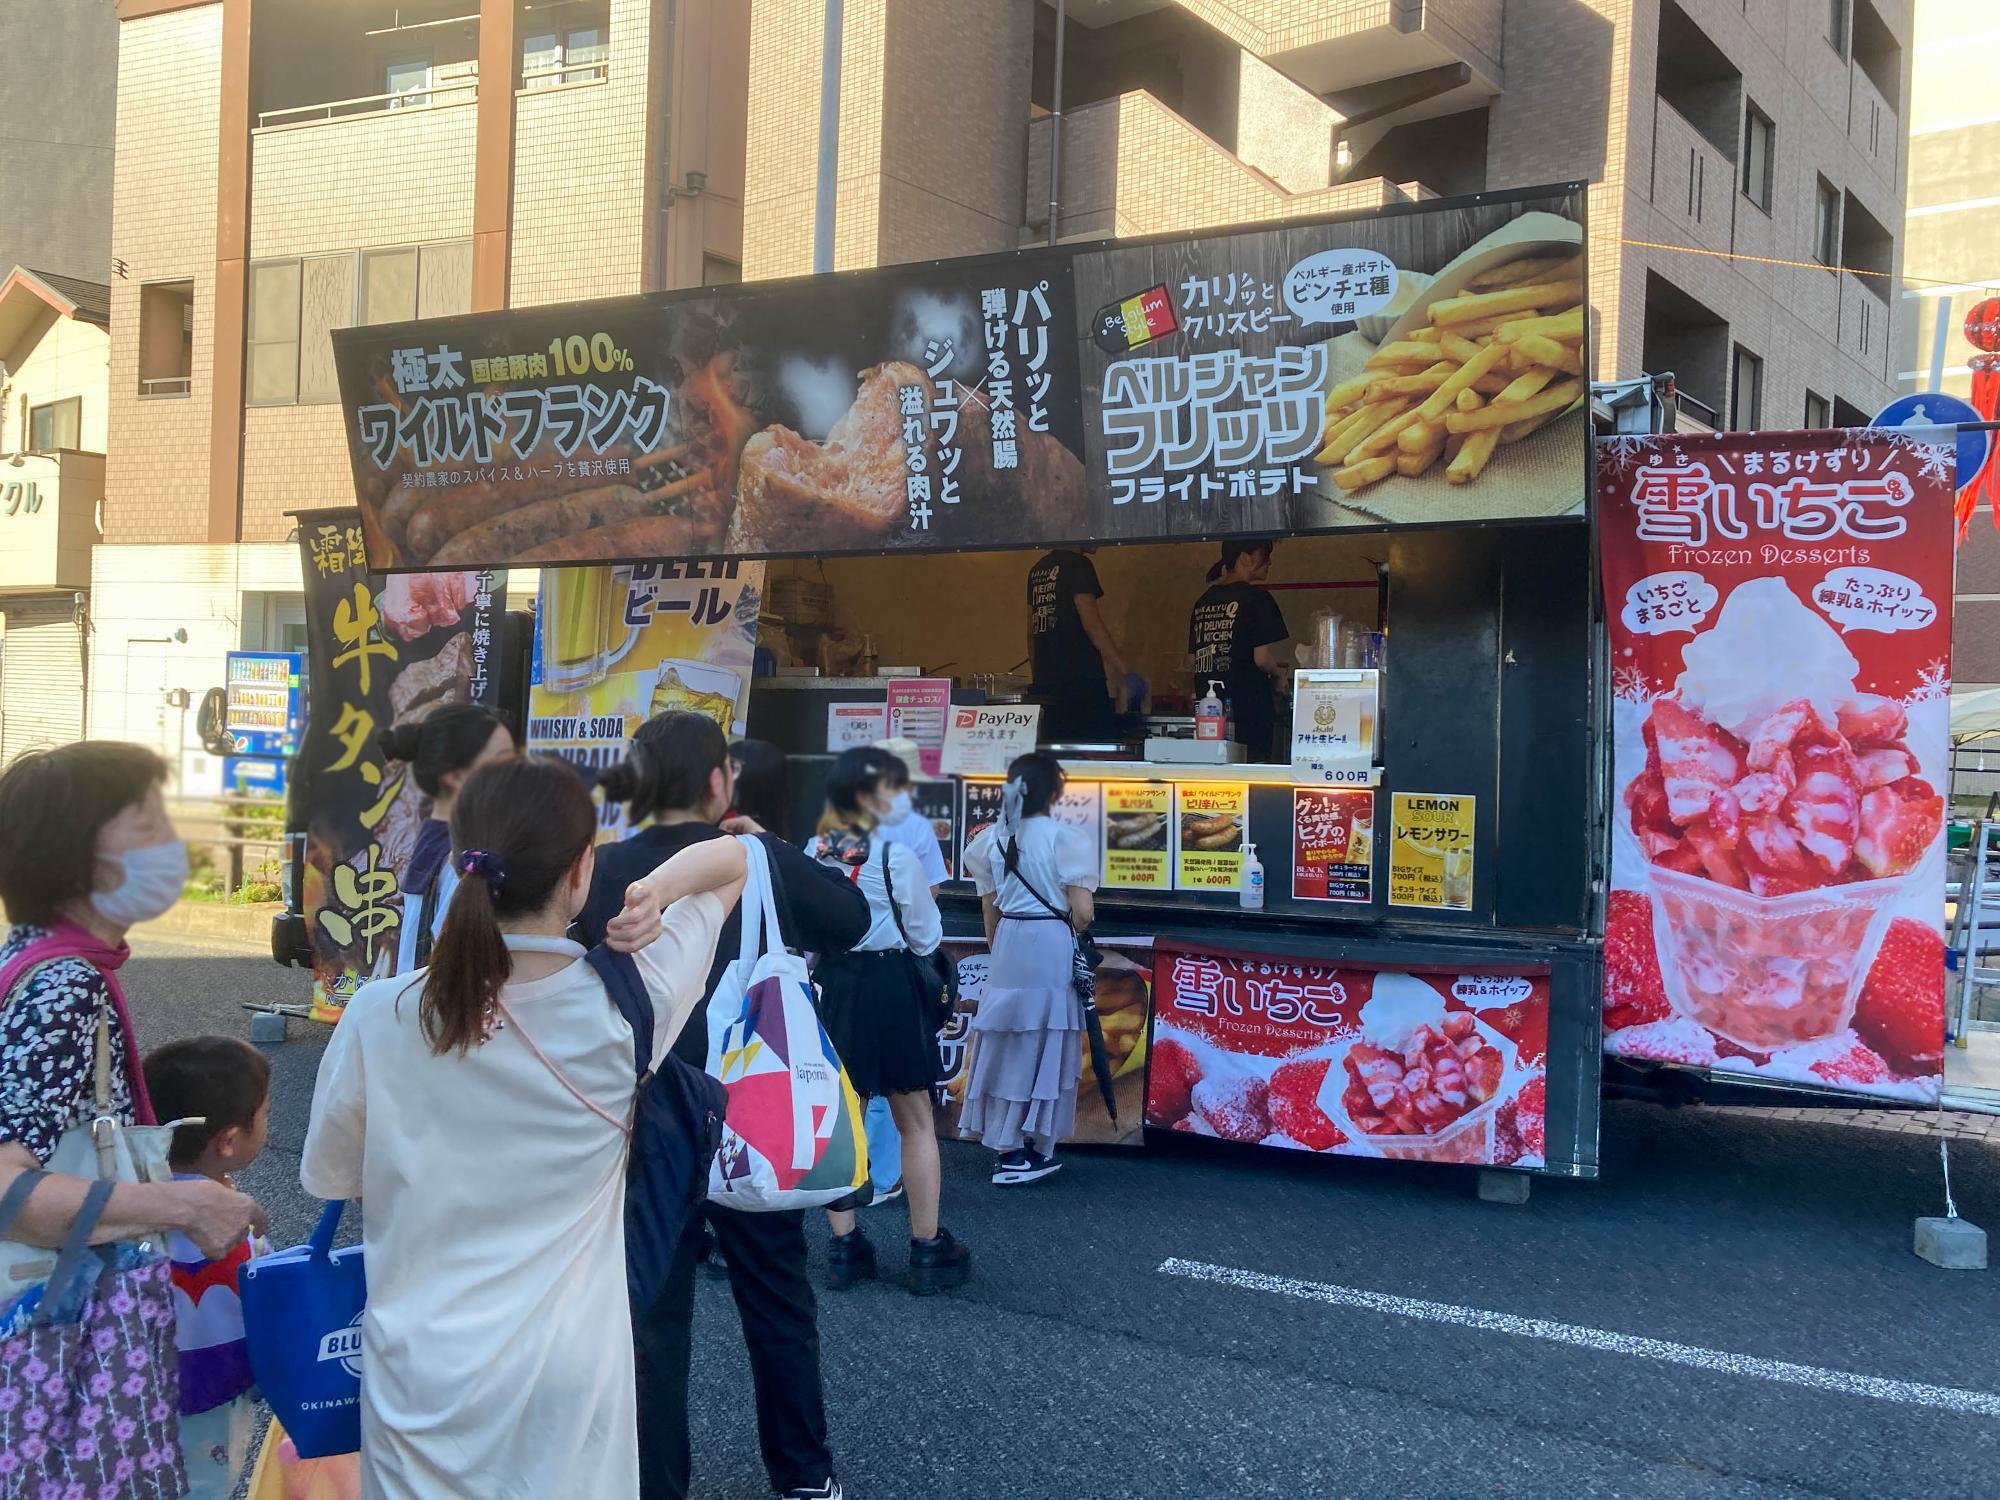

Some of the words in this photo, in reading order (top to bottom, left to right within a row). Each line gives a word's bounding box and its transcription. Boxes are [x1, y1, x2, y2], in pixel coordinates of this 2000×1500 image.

[1293, 260, 1391, 280] ベルギー産ポテト
[1180, 272, 1275, 310] カリッと
[1292, 275, 1390, 304] ビンチェ種
[1105, 299, 1164, 328] Belgium
[1330, 302, 1355, 316] 使用
[1182, 307, 1292, 339] クリスピー
[391, 344, 467, 394] 極太
[470, 332, 635, 385] 国産豚肉100%
[1012, 280, 1052, 432] パリッと
[981, 288, 1018, 470] 弾ける天然腸
[1102, 343, 1329, 404] ベルジャン
[358, 376, 671, 471] ワイルドフランク
[925, 338, 962, 505] ジュワッと
[1103, 391, 1326, 475] フリッツ
[899, 386, 934, 531] 溢れる肉汁
[1743, 448, 1871, 475] まるけずり
[1111, 466, 1318, 505] フライドポテト
[1630, 462, 1915, 547] 雪いちご
[1668, 544, 1753, 566] Frozen
[1760, 544, 1871, 566] Desserts
[1637, 580, 1689, 604] いちご
[1845, 577, 1912, 602] たっぷり
[624, 586, 732, 626] ビール
[1635, 598, 1702, 625] まるごと
[1817, 588, 1934, 623] 練乳&ホイップ
[529, 718, 577, 740] WHISKY
[578, 721, 587, 738] &
[589, 717, 623, 739] SODA
[978, 712, 1033, 727] PayPay
[967, 729, 1017, 740] つかえます
[1325, 770, 1368, 782] 600円
[1295, 796, 1341, 816] グッ!と
[1407, 799, 1459, 811] LEMON
[1412, 810, 1454, 823] SOUR
[1297, 821, 1345, 840] ヒゲの
[1301, 836, 1347, 849] ハイボール!
[1397, 826, 1470, 842] レモンサワー
[1130, 873, 1155, 882] 600円
[1206, 875, 1232, 885] 600円
[1172, 957, 1347, 1026] 雪いちご
[1217, 1017, 1261, 1035] Frozen
[1264, 1023, 1322, 1041] Desserts
